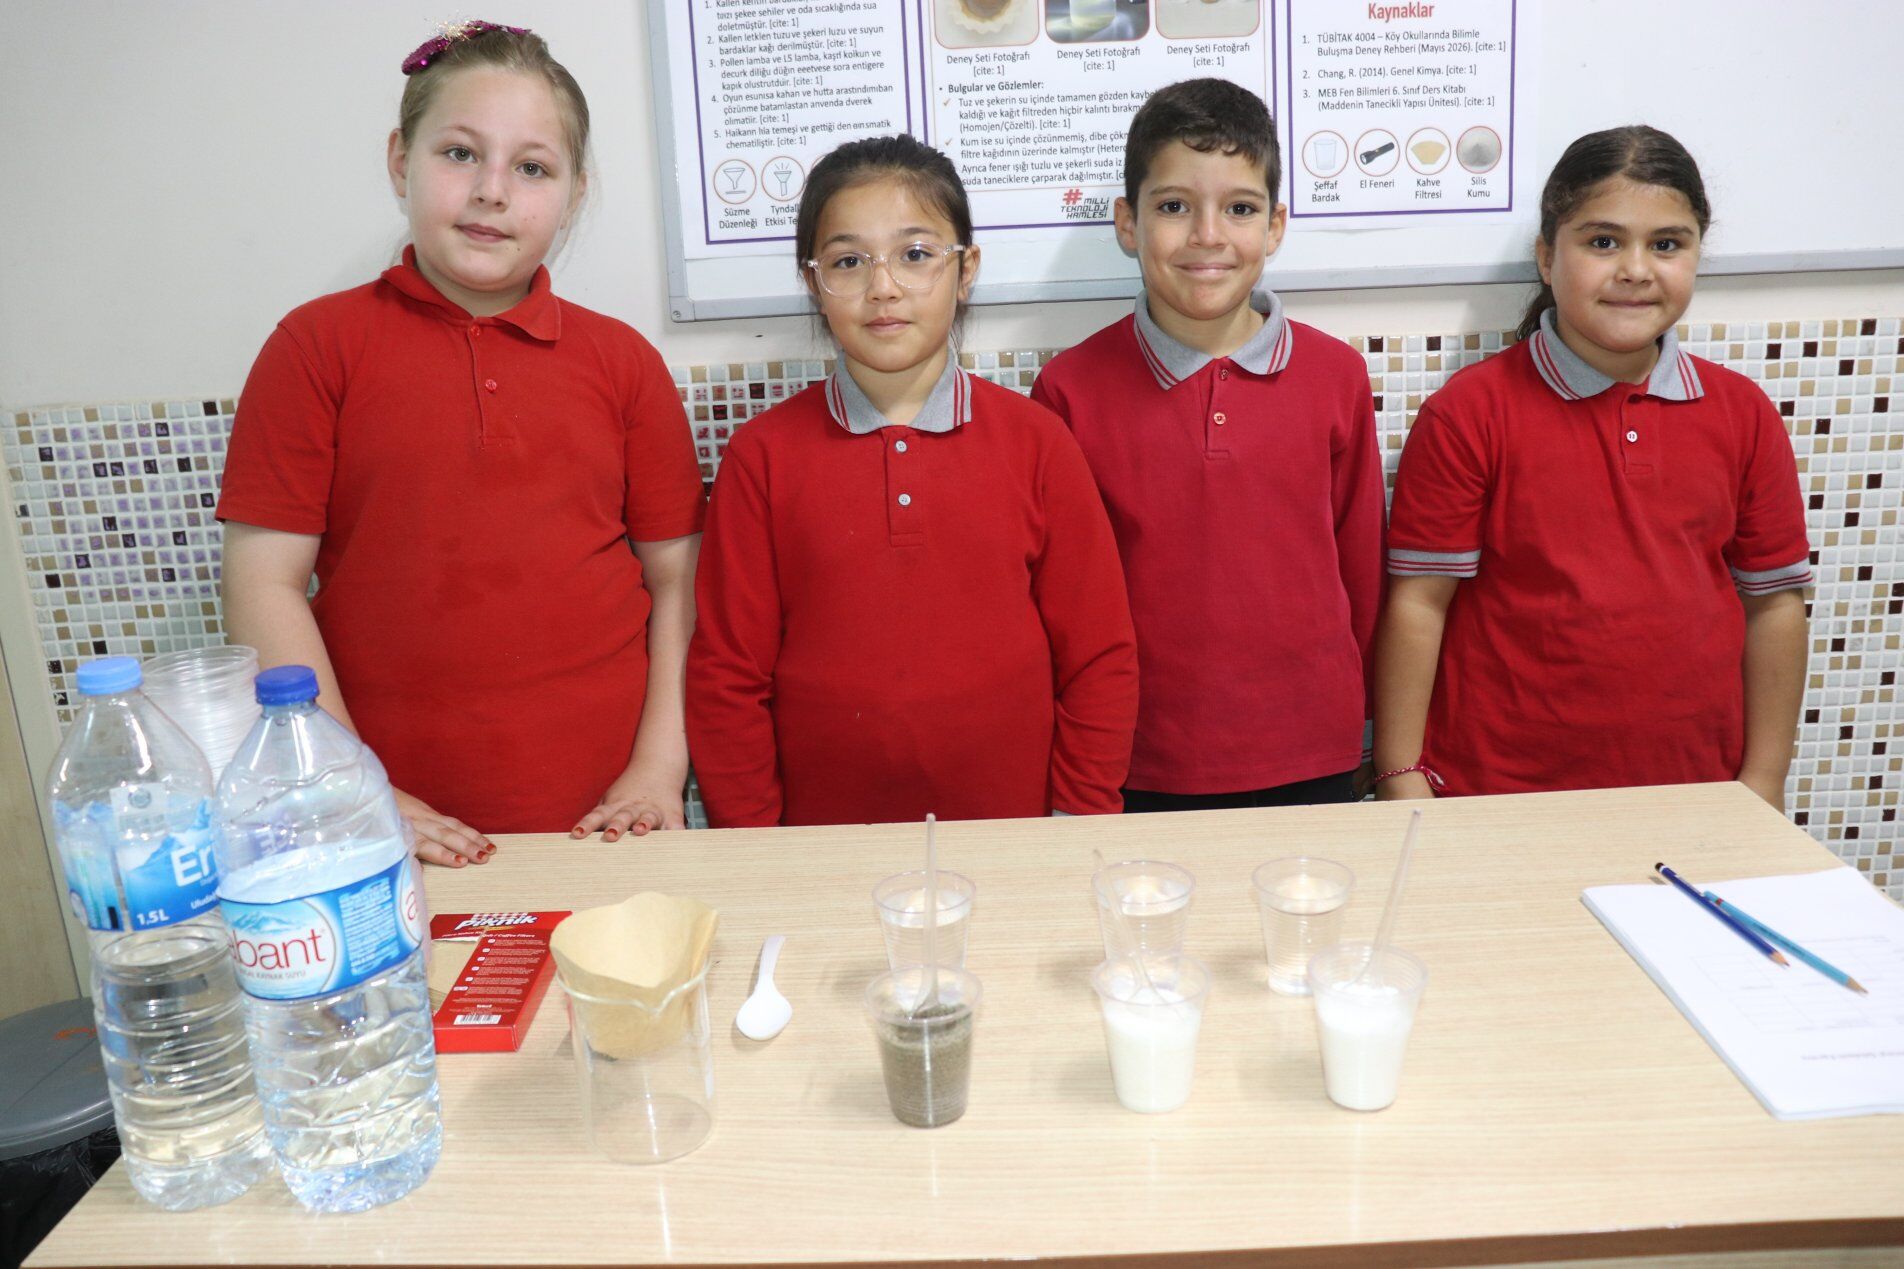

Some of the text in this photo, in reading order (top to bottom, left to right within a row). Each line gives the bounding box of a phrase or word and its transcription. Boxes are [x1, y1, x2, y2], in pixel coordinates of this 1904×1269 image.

[1368, 2, 1435, 23] Kaynaklar
[1302, 29, 1480, 44] 1. TÜBİTAK 4004 Köy Okullarında Bilimle
[1057, 46, 1140, 60] Deney Seti Fotoğrafı
[1167, 42, 1250, 55] Deney Seti Fotoğrafı
[1317, 40, 1506, 57] Buluşma Deney Rehberi (Mayıs 2026). [cite: 1]
[946, 51, 1030, 65] Deney Seti Fotoğrafı
[1193, 55, 1224, 68] [cite: 1]
[973, 64, 1004, 77] [cite: 1]
[1083, 59, 1115, 72] [cite: 1]
[1302, 64, 1476, 80] 2. Chang, R. (2014). Genel Kimya. [cite: 1]
[948, 83, 983, 94] Bulgular
[997, 80, 1043, 90] Gözlemler:
[1303, 84, 1466, 98] 3. MEB Fen Bilimleri 6. Sınıf Ders Kitabı
[958, 97, 973, 107] Tuz
[974, 98, 984, 106] ve
[986, 95, 1016, 107] şekerin
[1030, 93, 1055, 105] içinde
[1057, 94, 1096, 102] tamamen
[1098, 91, 1128, 102] gözden
[1318, 95, 1494, 111] (Maddenin Tanecikli Yapısı Ünitesi). [cite: 1]
[959, 103, 1142, 120] kaldığı ve kağıt filtreden hiçbir kalıntı bırakm
[959, 117, 1071, 133] (Homojen/Çözelti). [cite: 1]
[960, 131, 1107, 146] Kum ise su içinde çözünmemiş, dibe
[960, 145, 1095, 159] filtre kağıdının üzerinde kalmıştır
[961, 157, 1122, 175] Ayrıca fener ışığı tuzlu ve şekerli suda iz
[962, 171, 1113, 186] suda taneciklere çarparak dağılmıştır.
[1314, 180, 1338, 191] Şeffaf
[1360, 179, 1394, 189] El Feneri
[1416, 178, 1440, 187] Kahve
[1471, 176, 1486, 185] Silis
[1312, 193, 1341, 202] Bardak
[1415, 189, 1441, 199] Filtresi
[1467, 189, 1490, 198] Kumu
[724, 207, 751, 217] Süzme
[718, 218, 757, 229] Düzenleği
[765, 216, 786, 226] Etkisi
[170, 846, 213, 887] Er
[136, 908, 170, 926] 1,5L
[228, 928, 326, 971] bant
